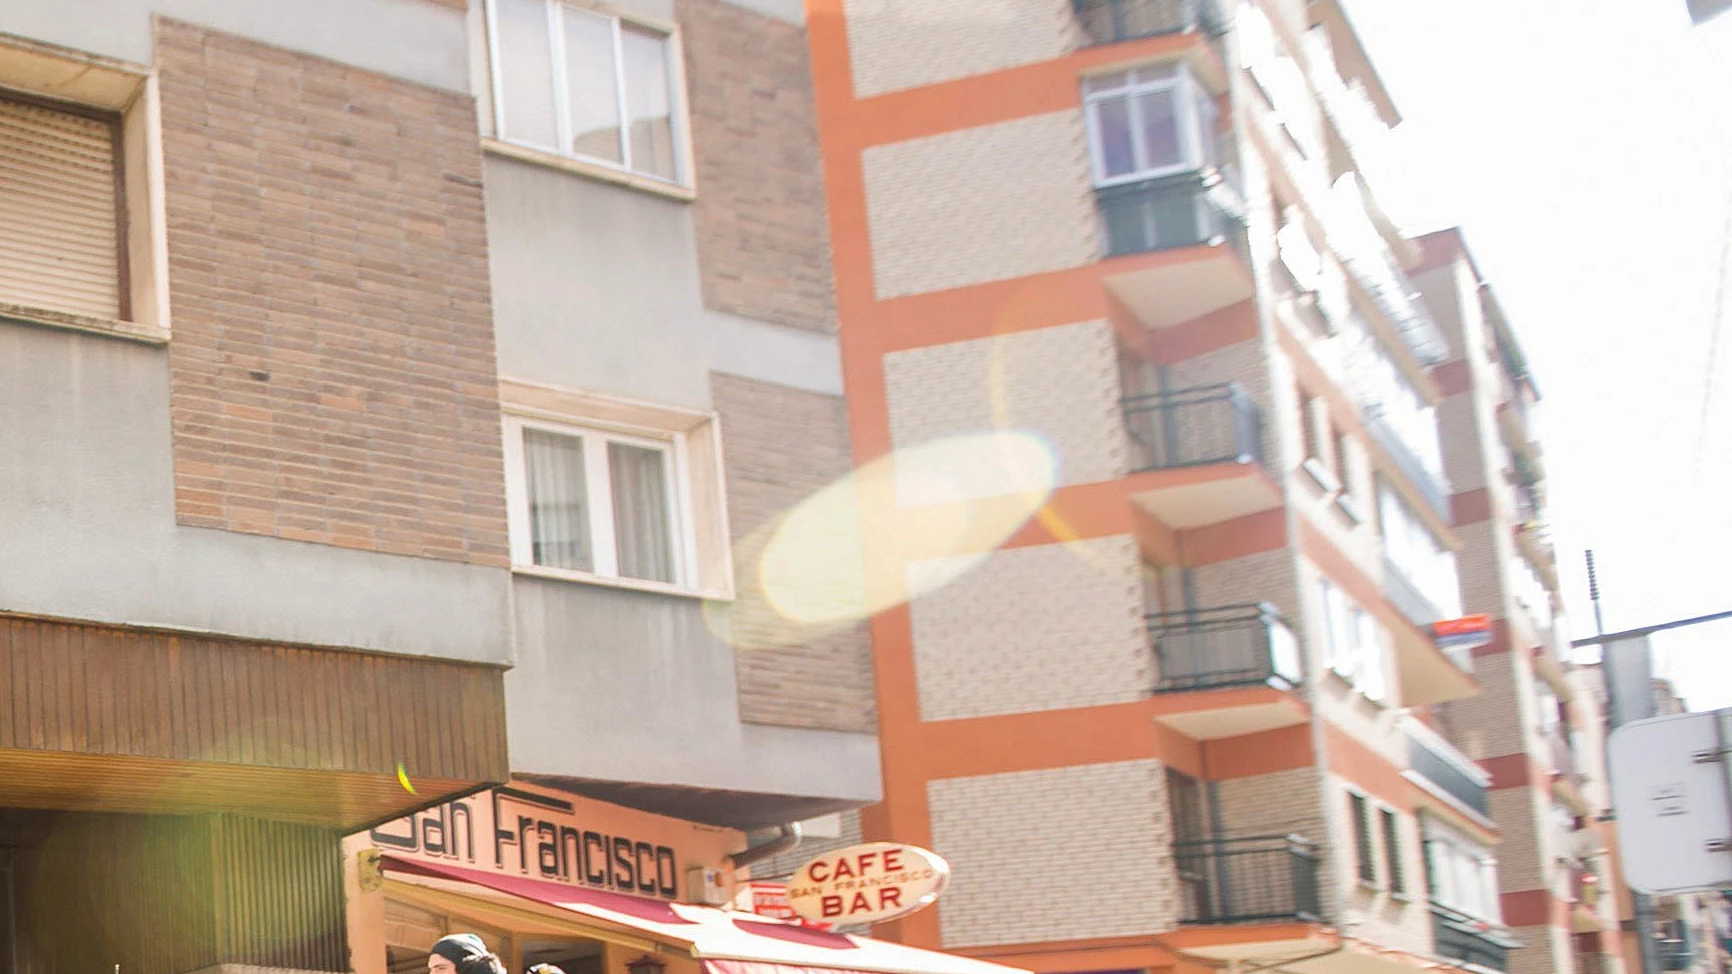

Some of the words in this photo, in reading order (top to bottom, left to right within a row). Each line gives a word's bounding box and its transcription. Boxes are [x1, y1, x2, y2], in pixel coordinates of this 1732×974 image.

[492, 786, 679, 900] Francisco
[808, 848, 905, 884] CAFE
[789, 886, 822, 900] SAN
[834, 868, 933, 890] FRANCISCO
[821, 886, 902, 918] BAR
